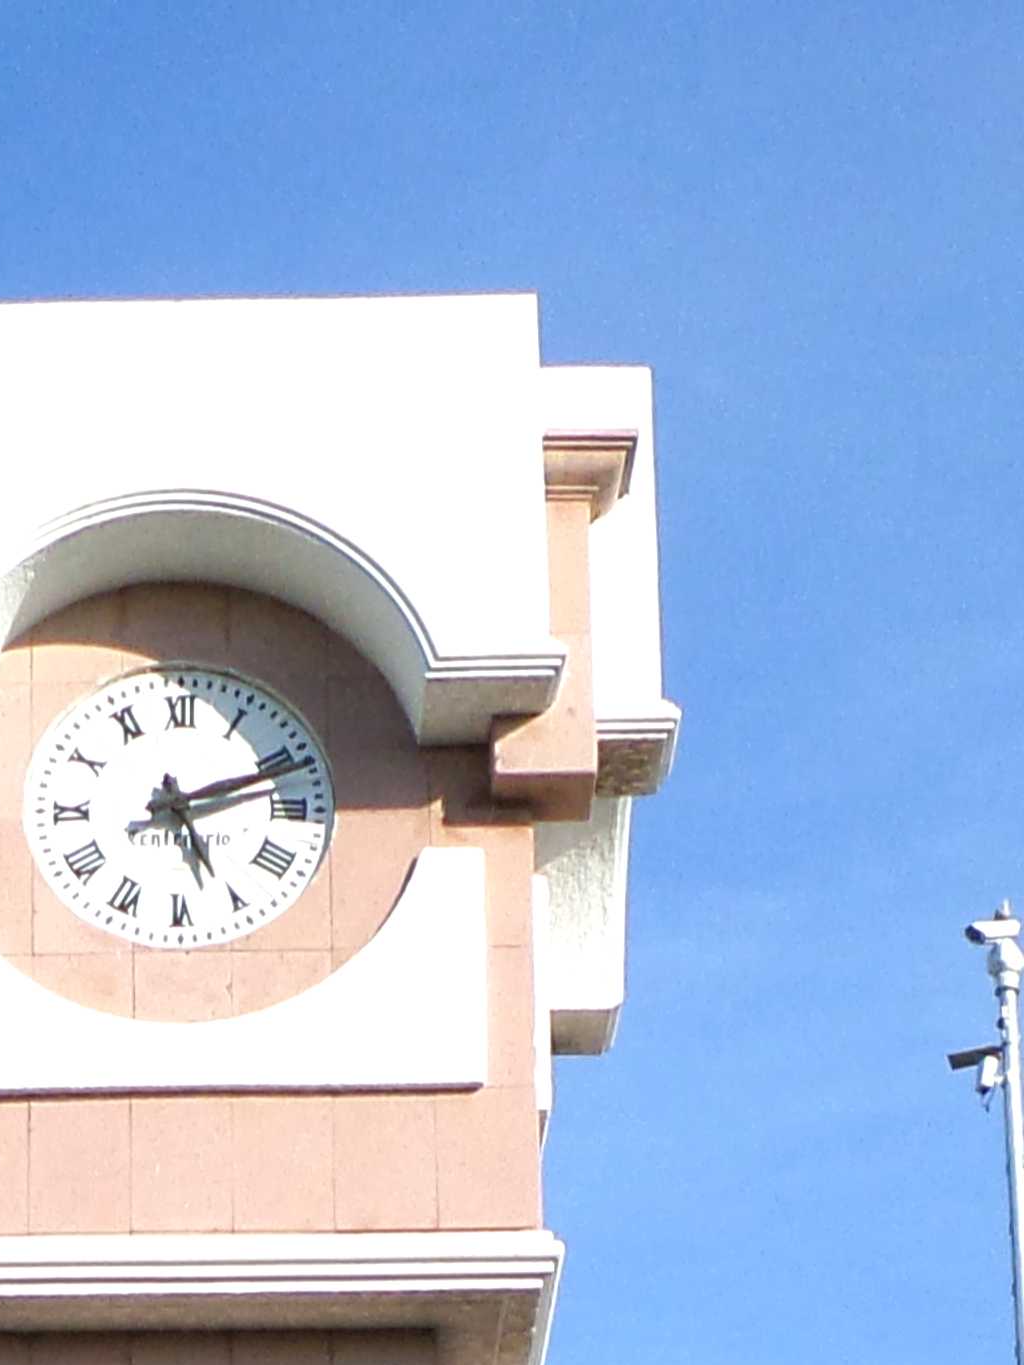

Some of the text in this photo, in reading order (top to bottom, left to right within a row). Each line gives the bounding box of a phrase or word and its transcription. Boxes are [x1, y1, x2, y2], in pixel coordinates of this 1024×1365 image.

[109, 704, 145, 745] XI
[165, 695, 197, 730] XII
[68, 747, 107, 777] X
[53, 800, 90, 826] IX
[169, 894, 194, 928] VI
